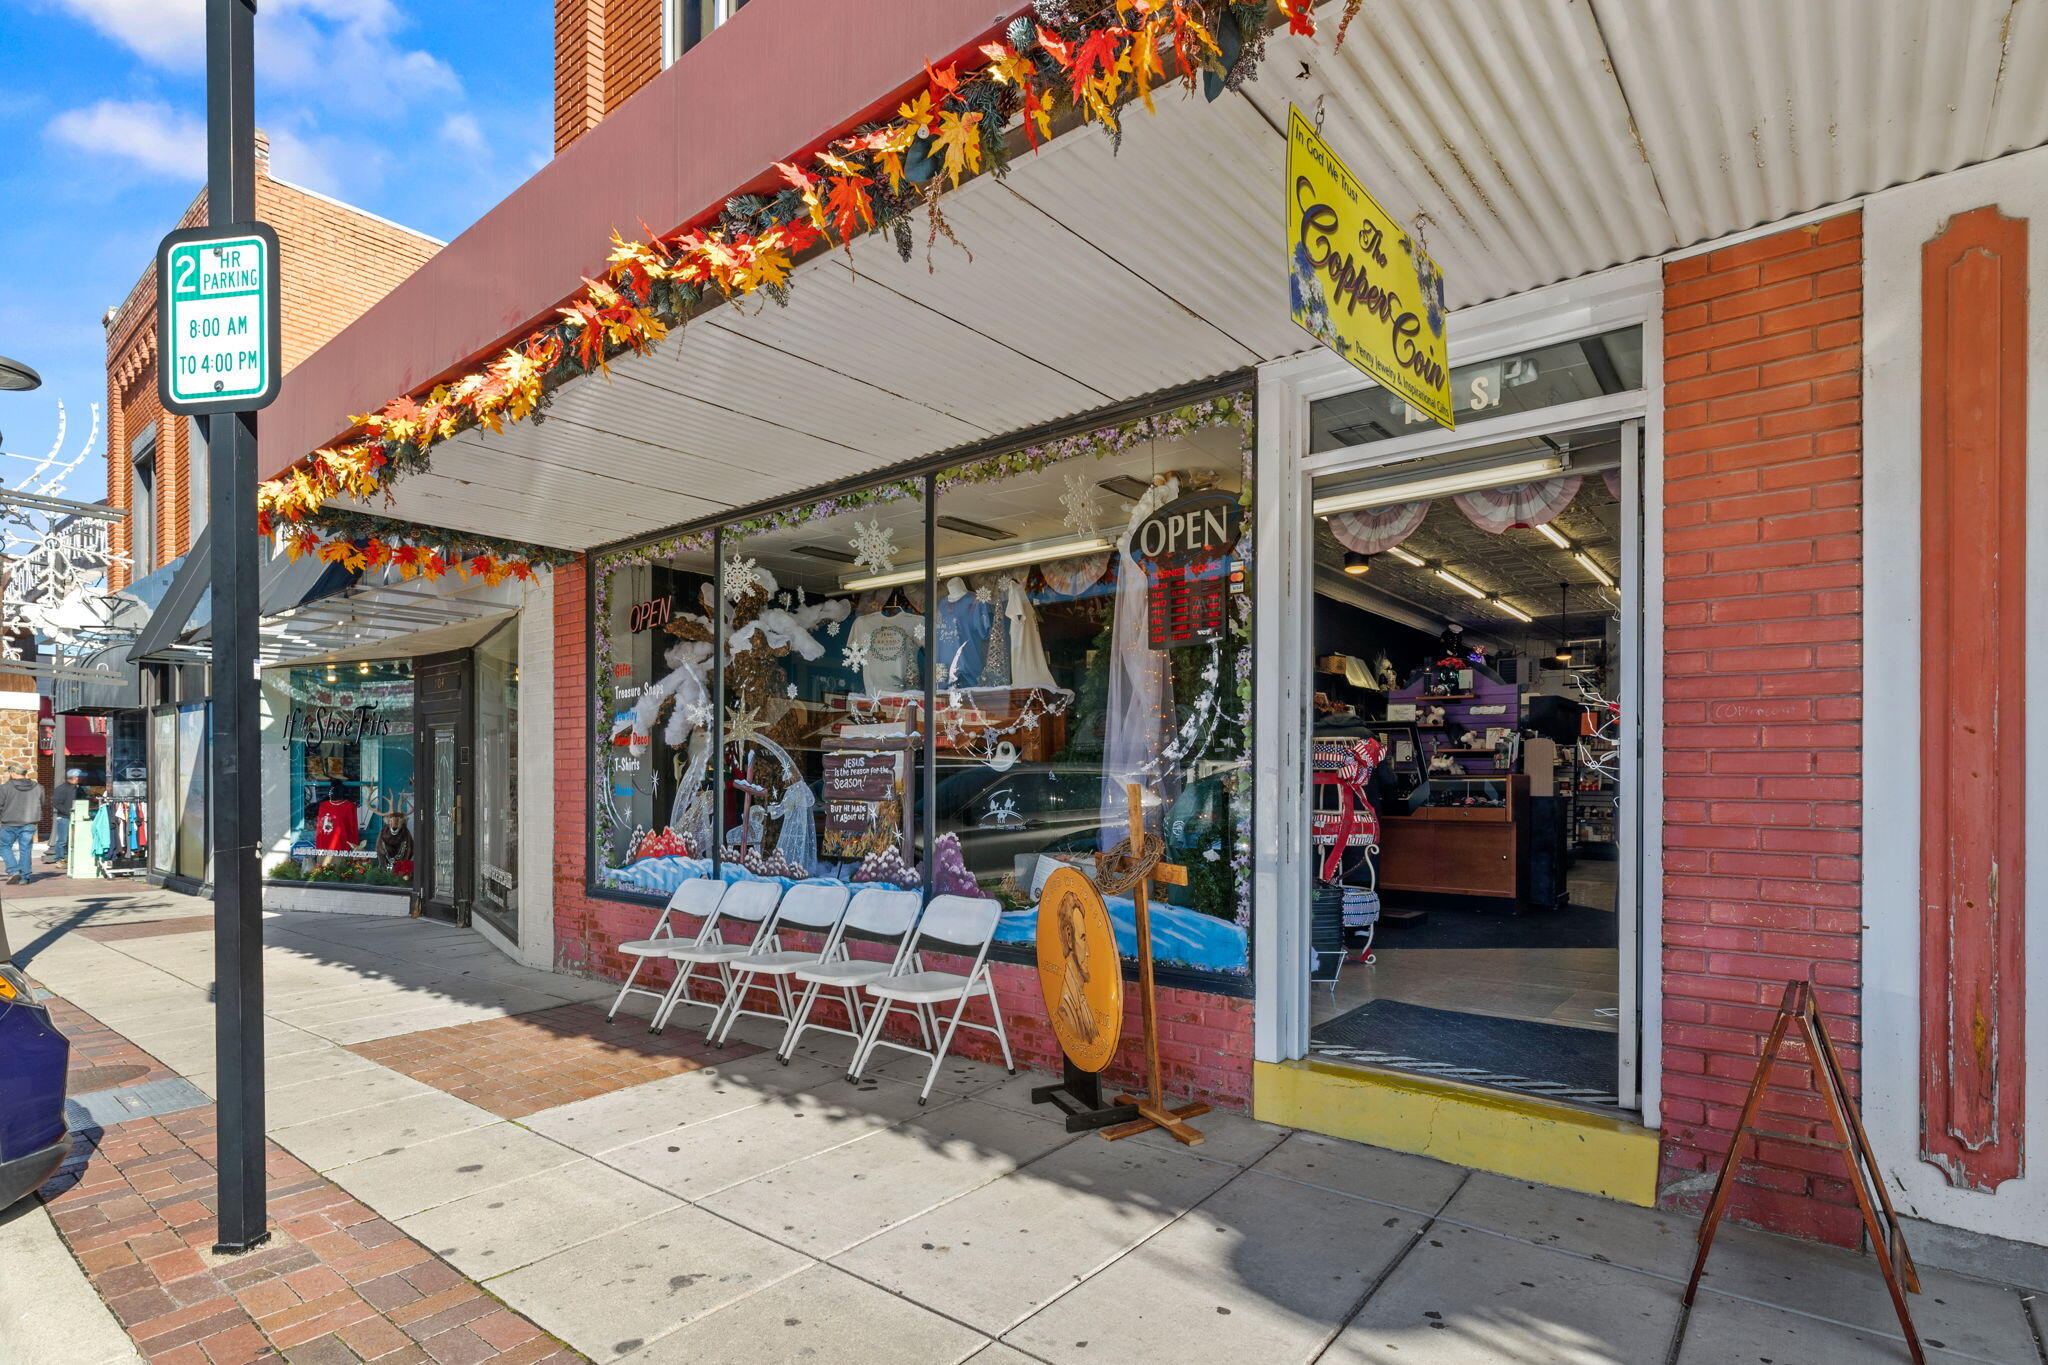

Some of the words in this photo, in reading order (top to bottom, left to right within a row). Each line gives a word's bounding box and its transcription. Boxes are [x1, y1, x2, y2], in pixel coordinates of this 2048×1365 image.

[1296, 124, 1304, 145] In
[1306, 137, 1324, 167] God
[1326, 157, 1338, 182] We
[1341, 173, 1358, 204] Trust
[1358, 218, 1388, 269] The
[220, 250, 241, 269] HR
[176, 255, 196, 293] 2
[203, 268, 258, 291] PARKING
[1296, 175, 1391, 324] Copper
[1389, 291, 1446, 392] Coin
[189, 317, 220, 339] 8:00
[227, 315, 248, 336] AM
[180, 354, 197, 375] TO
[201, 352, 233, 374] 4:00
[239, 350, 258, 371] PM
[1355, 340, 1374, 368] Penny
[1375, 355, 1396, 384] Jewelry
[1403, 376, 1436, 409] Inspirational
[1140, 505, 1227, 557] OPEN
[630, 594, 672, 633] OPEN
[614, 663, 632, 678] Gifts
[615, 685, 641, 700] Treasure
[643, 681, 664, 699] Snaps
[282, 707, 301, 751] If
[305, 706, 353, 749] Shoe
[350, 700, 391, 747] Fits
[615, 708, 638, 724] Jewelry
[633, 732, 652, 745] Decor
[615, 757, 641, 772] T-Shirts
[840, 768, 849, 776] the
[850, 767, 870, 775] reason
[870, 767, 879, 775] for
[880, 766, 889, 774] the
[843, 757, 865, 769] JESUS
[834, 775, 867, 791] Season!
[830, 804, 842, 813] BUT
[844, 804, 851, 812] HE
[851, 805, 866, 813] MADE
[840, 813, 857, 823] ABOUT
[858, 813, 865, 821] US
